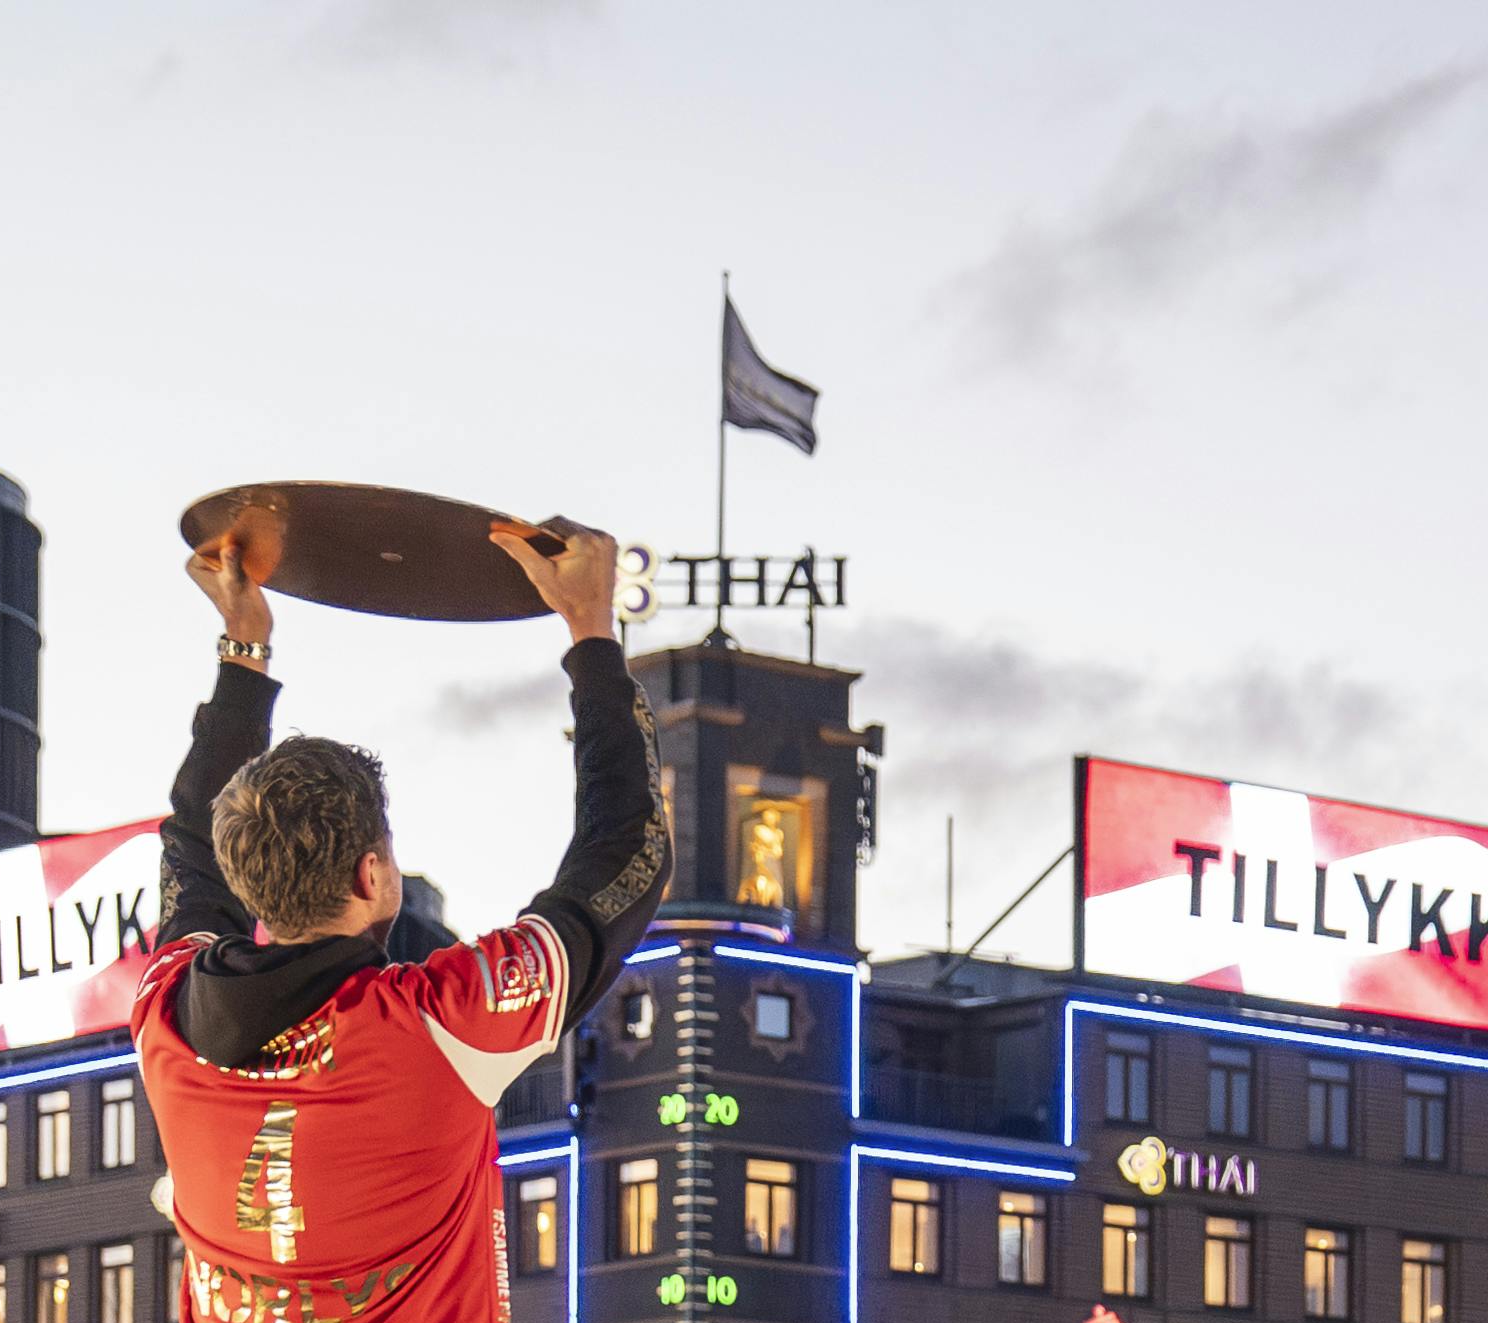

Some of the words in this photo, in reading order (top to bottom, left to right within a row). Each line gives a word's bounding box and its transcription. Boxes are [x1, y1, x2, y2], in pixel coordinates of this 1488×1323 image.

[668, 555, 847, 607] THAI
[705, 1093, 739, 1126] 20
[237, 1100, 304, 1264] 4
[1171, 1152, 1256, 1196] THAI
[707, 1275, 737, 1306] 10
